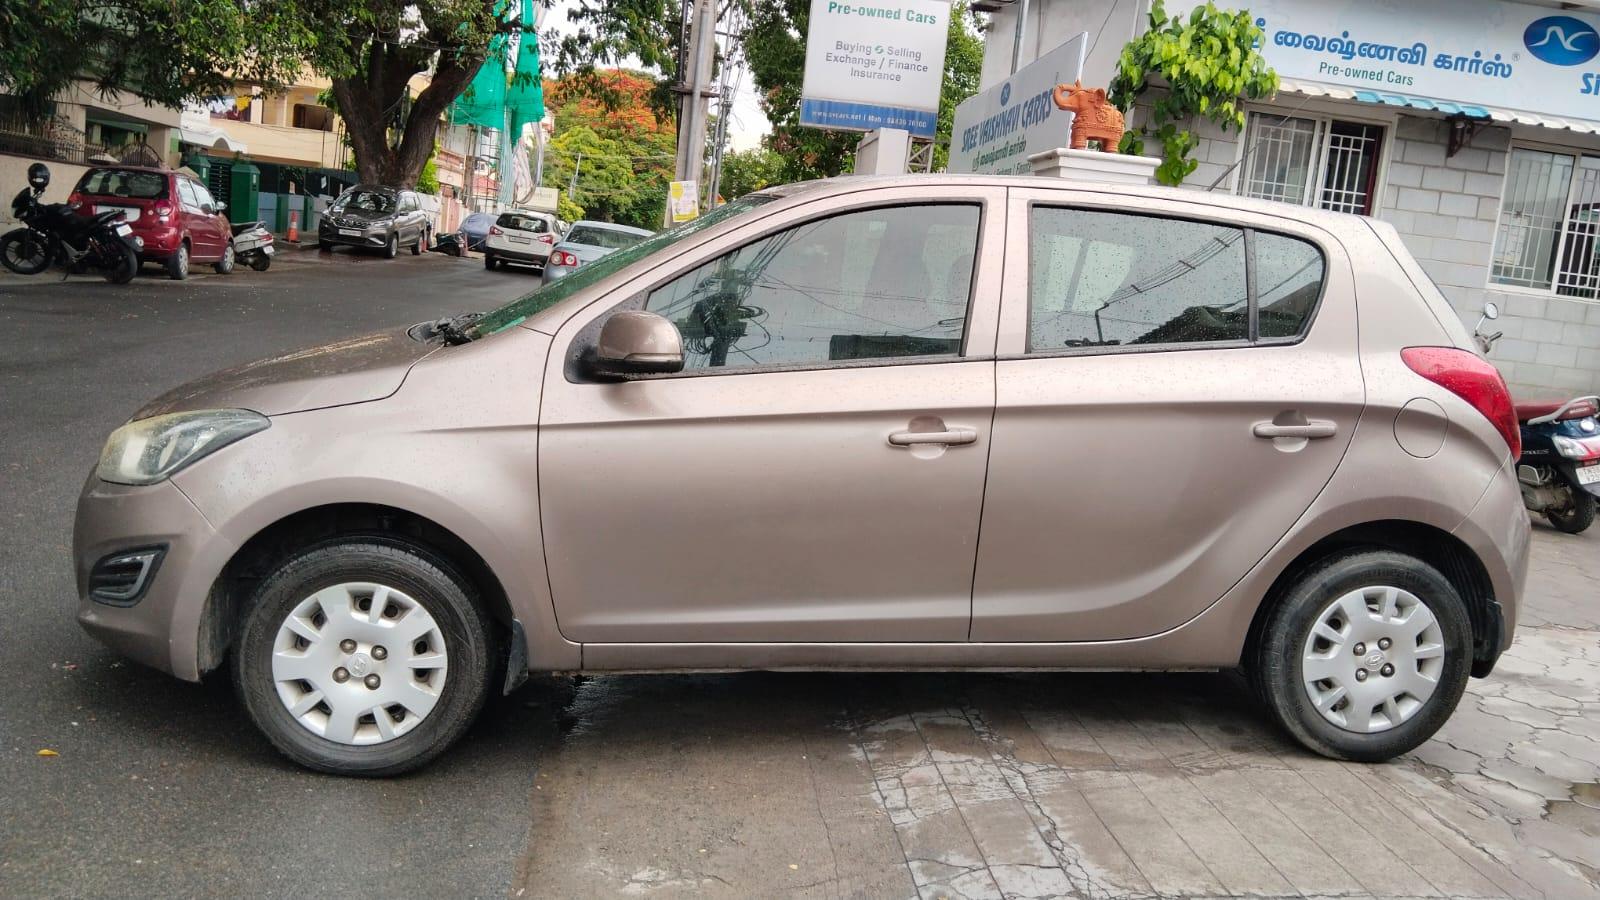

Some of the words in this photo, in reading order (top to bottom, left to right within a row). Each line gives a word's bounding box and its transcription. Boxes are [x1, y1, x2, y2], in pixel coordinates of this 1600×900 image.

[828, 1, 901, 21] Pre-owned
[905, 9, 937, 25] Cars
[825, 52, 877, 67] Exchange
[888, 59, 928, 73] Finance
[835, 40, 872, 56] Buying
[887, 46, 922, 62] Selling
[1274, 30, 1427, 67] வைஷ்ணவி
[1433, 50, 1512, 79] கார்ஸ்
[850, 67, 902, 82] Insurance
[1319, 61, 1383, 82] Pre-owned
[1387, 70, 1414, 86] Cars
[961, 124, 979, 153] SREE
[978, 103, 1021, 146] VAISHNAVI
[1021, 87, 1054, 129] CARRS
